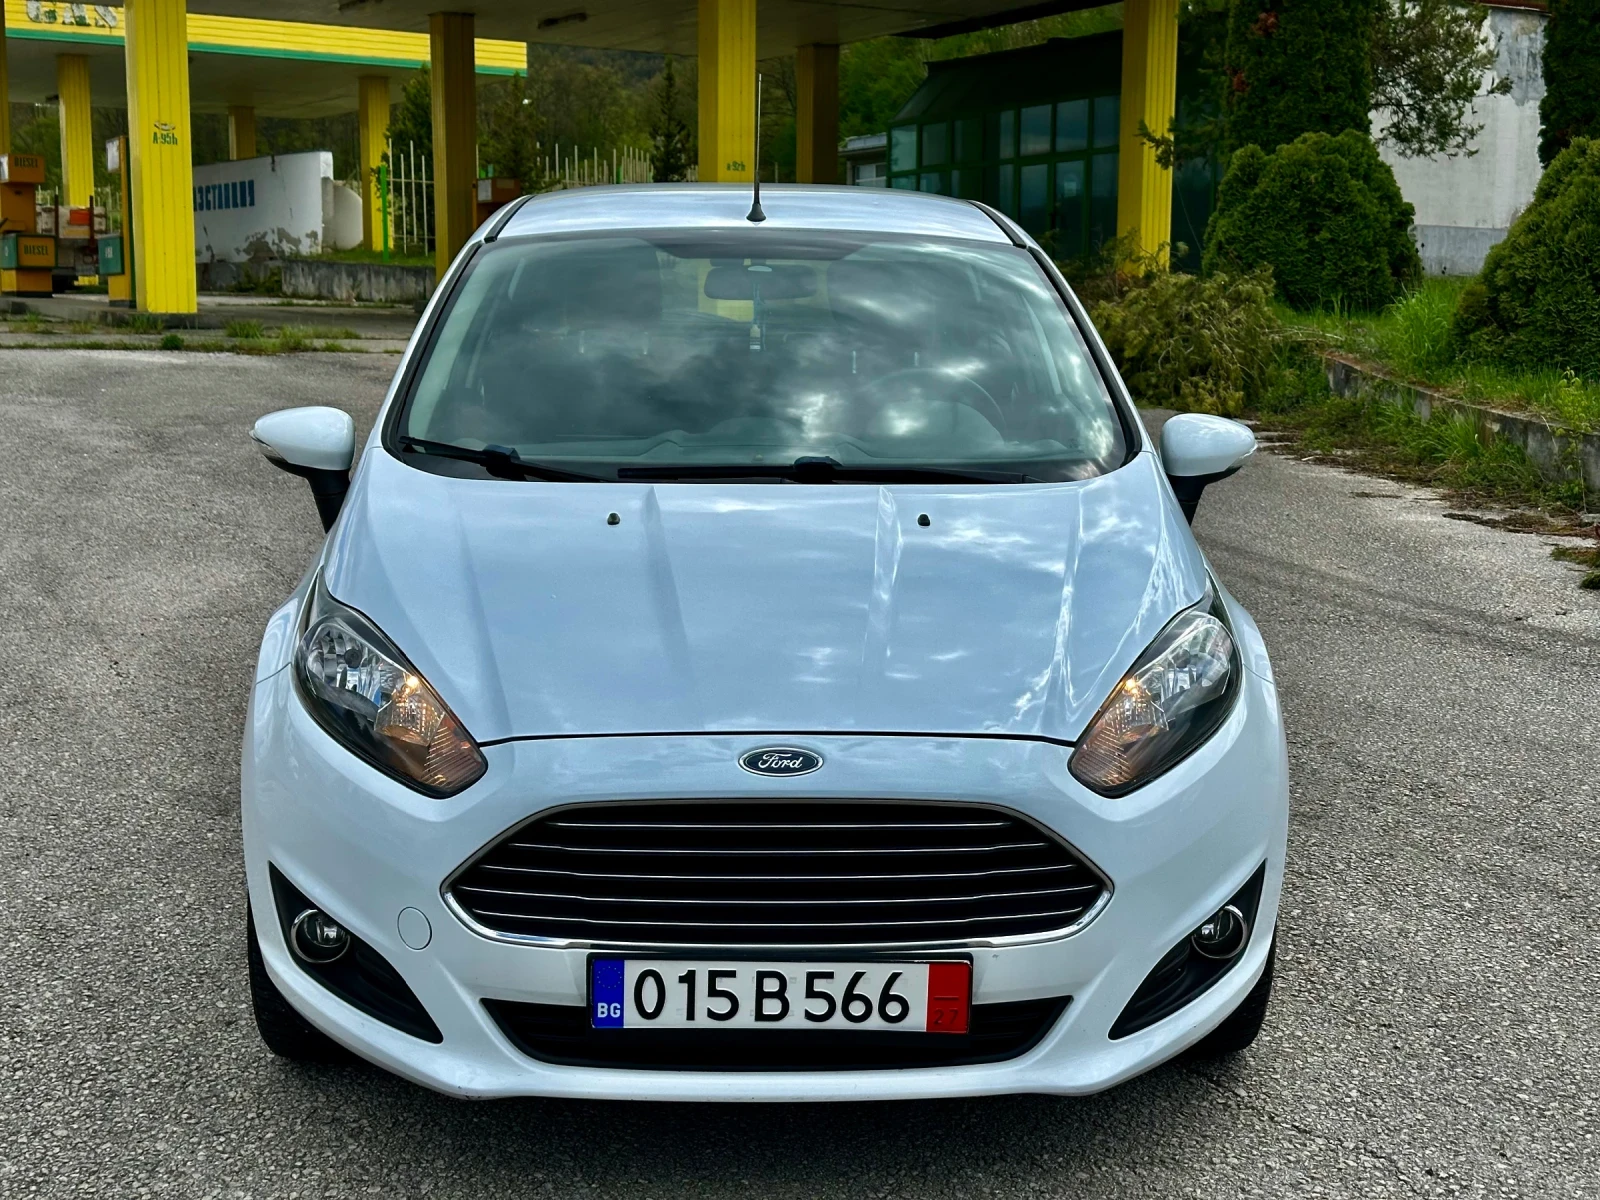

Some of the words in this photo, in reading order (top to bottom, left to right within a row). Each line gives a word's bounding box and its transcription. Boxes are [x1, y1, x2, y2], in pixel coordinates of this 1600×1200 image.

[14, 156, 39, 168] DIESEL
[23, 244, 49, 256] DIESEL
[758, 752, 804, 769] Ford
[597, 1002, 621, 1018] BG
